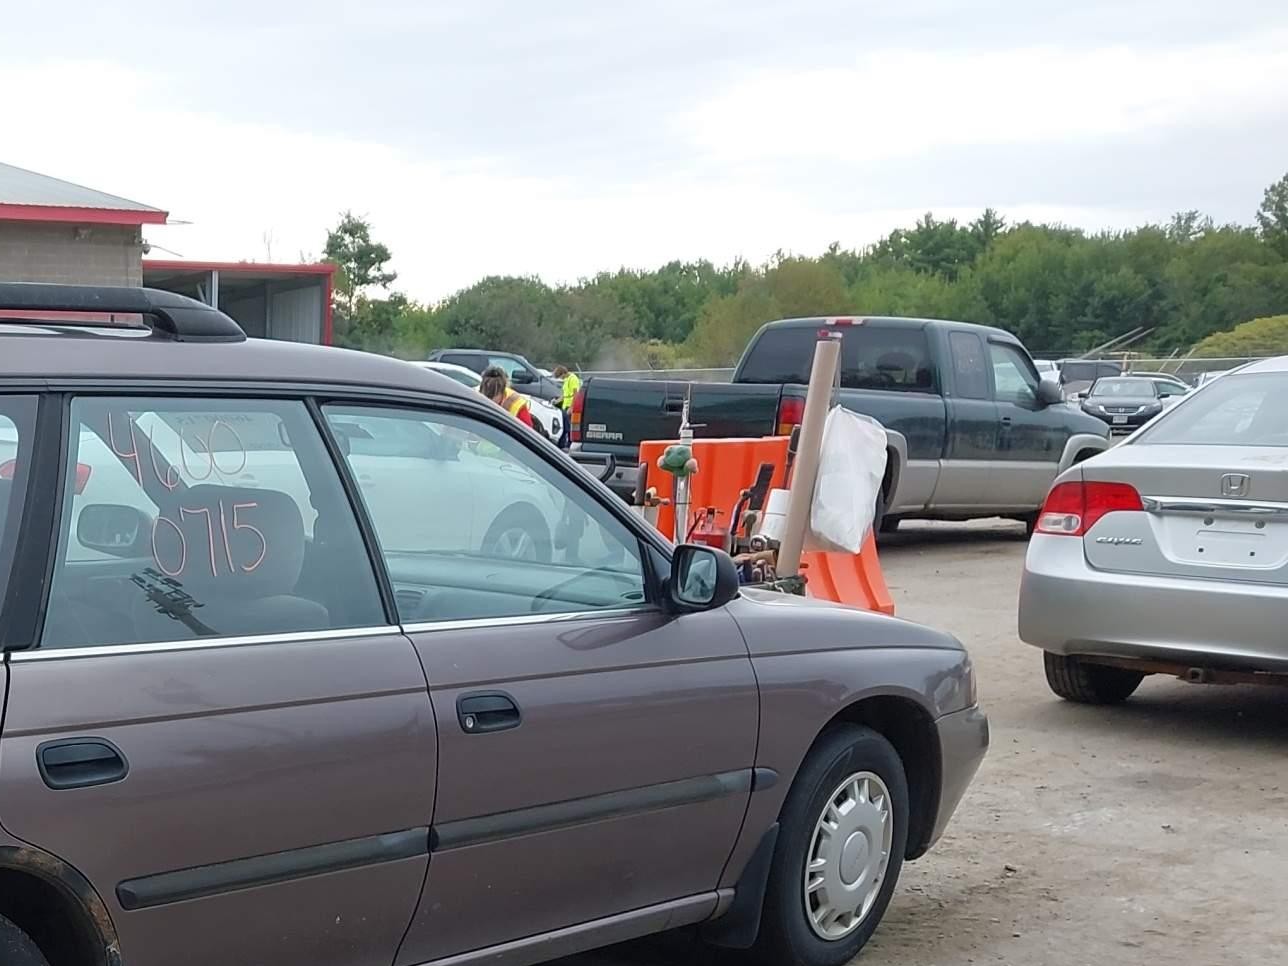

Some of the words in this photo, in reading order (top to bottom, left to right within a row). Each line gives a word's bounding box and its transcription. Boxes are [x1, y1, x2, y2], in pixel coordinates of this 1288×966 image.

[108, 411, 247, 492] 4600
[586, 431, 623, 441] SIERRA
[152, 498, 266, 577] 0715
